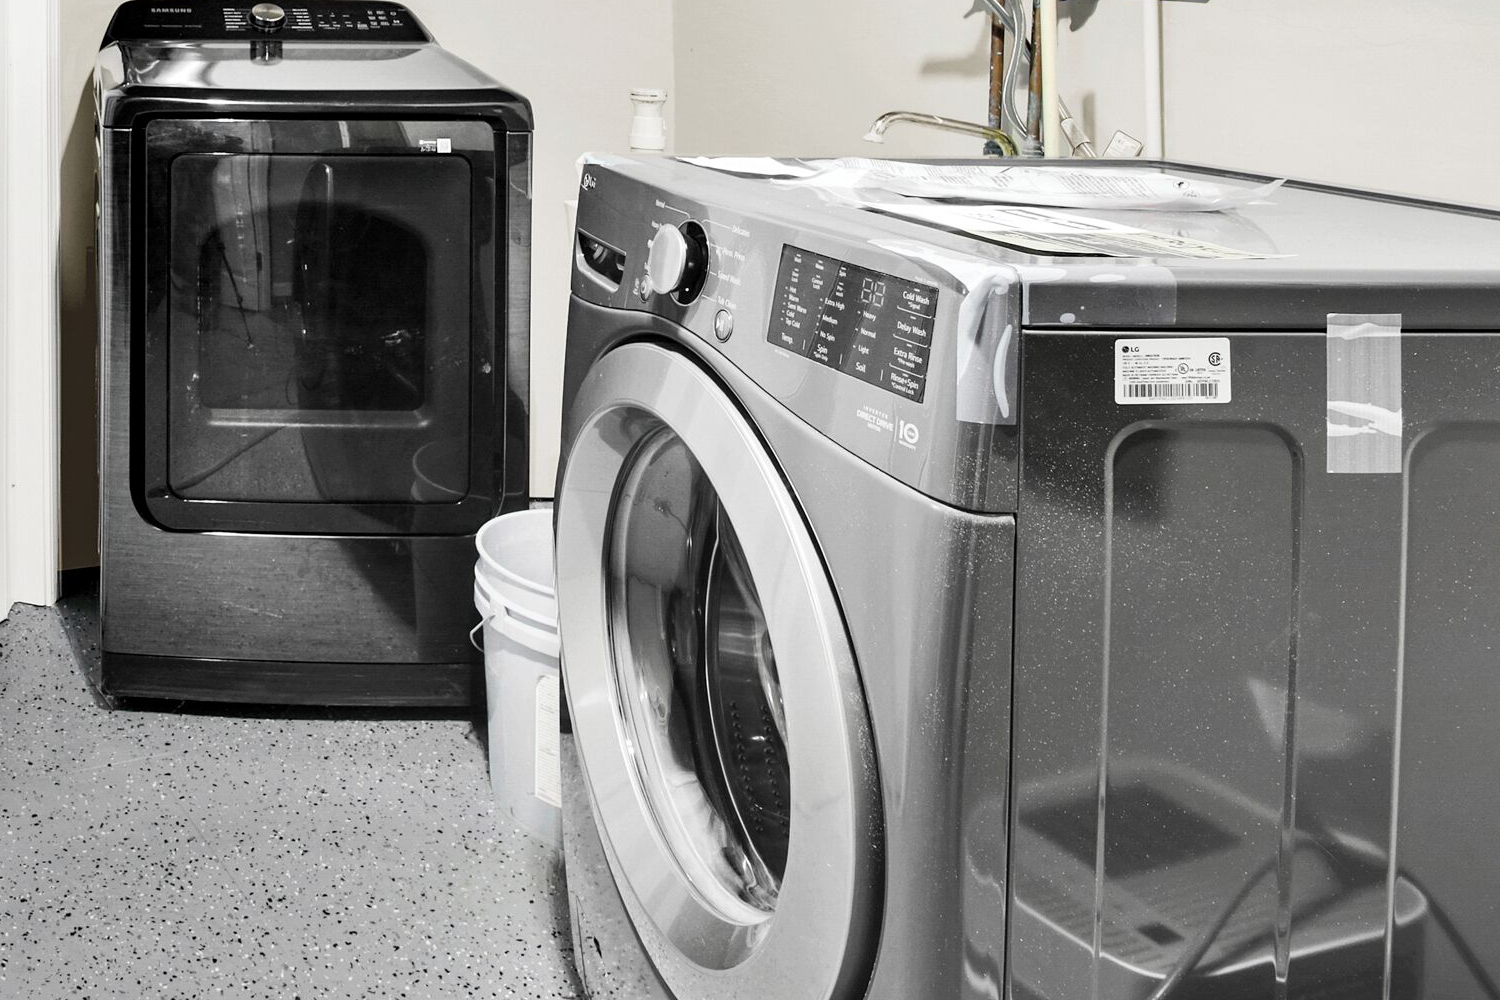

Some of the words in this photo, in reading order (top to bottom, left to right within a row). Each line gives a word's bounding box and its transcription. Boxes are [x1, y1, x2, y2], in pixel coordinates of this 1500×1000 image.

[903, 291, 915, 301] Cold
[916, 294, 930, 305] Wash
[825, 298, 835, 306] Extra
[836, 301, 845, 310] High
[786, 310, 795, 318] Cold
[822, 314, 838, 325] Medium
[863, 311, 876, 321] Heavy
[792, 320, 800, 328] Cold
[897, 321, 911, 333] Delay
[912, 326, 926, 337] Wash
[827, 333, 835, 341] Spin
[861, 328, 876, 338] Normal
[817, 344, 828, 354] Spin
[858, 345, 869, 355] Light
[893, 347, 907, 358] Extra
[908, 352, 923, 364] Rinse
[856, 362, 866, 373] Soil
[857, 409, 876, 423] DIRECT
[876, 417, 894, 432] DRIVE
[900, 419, 919, 444] 10
